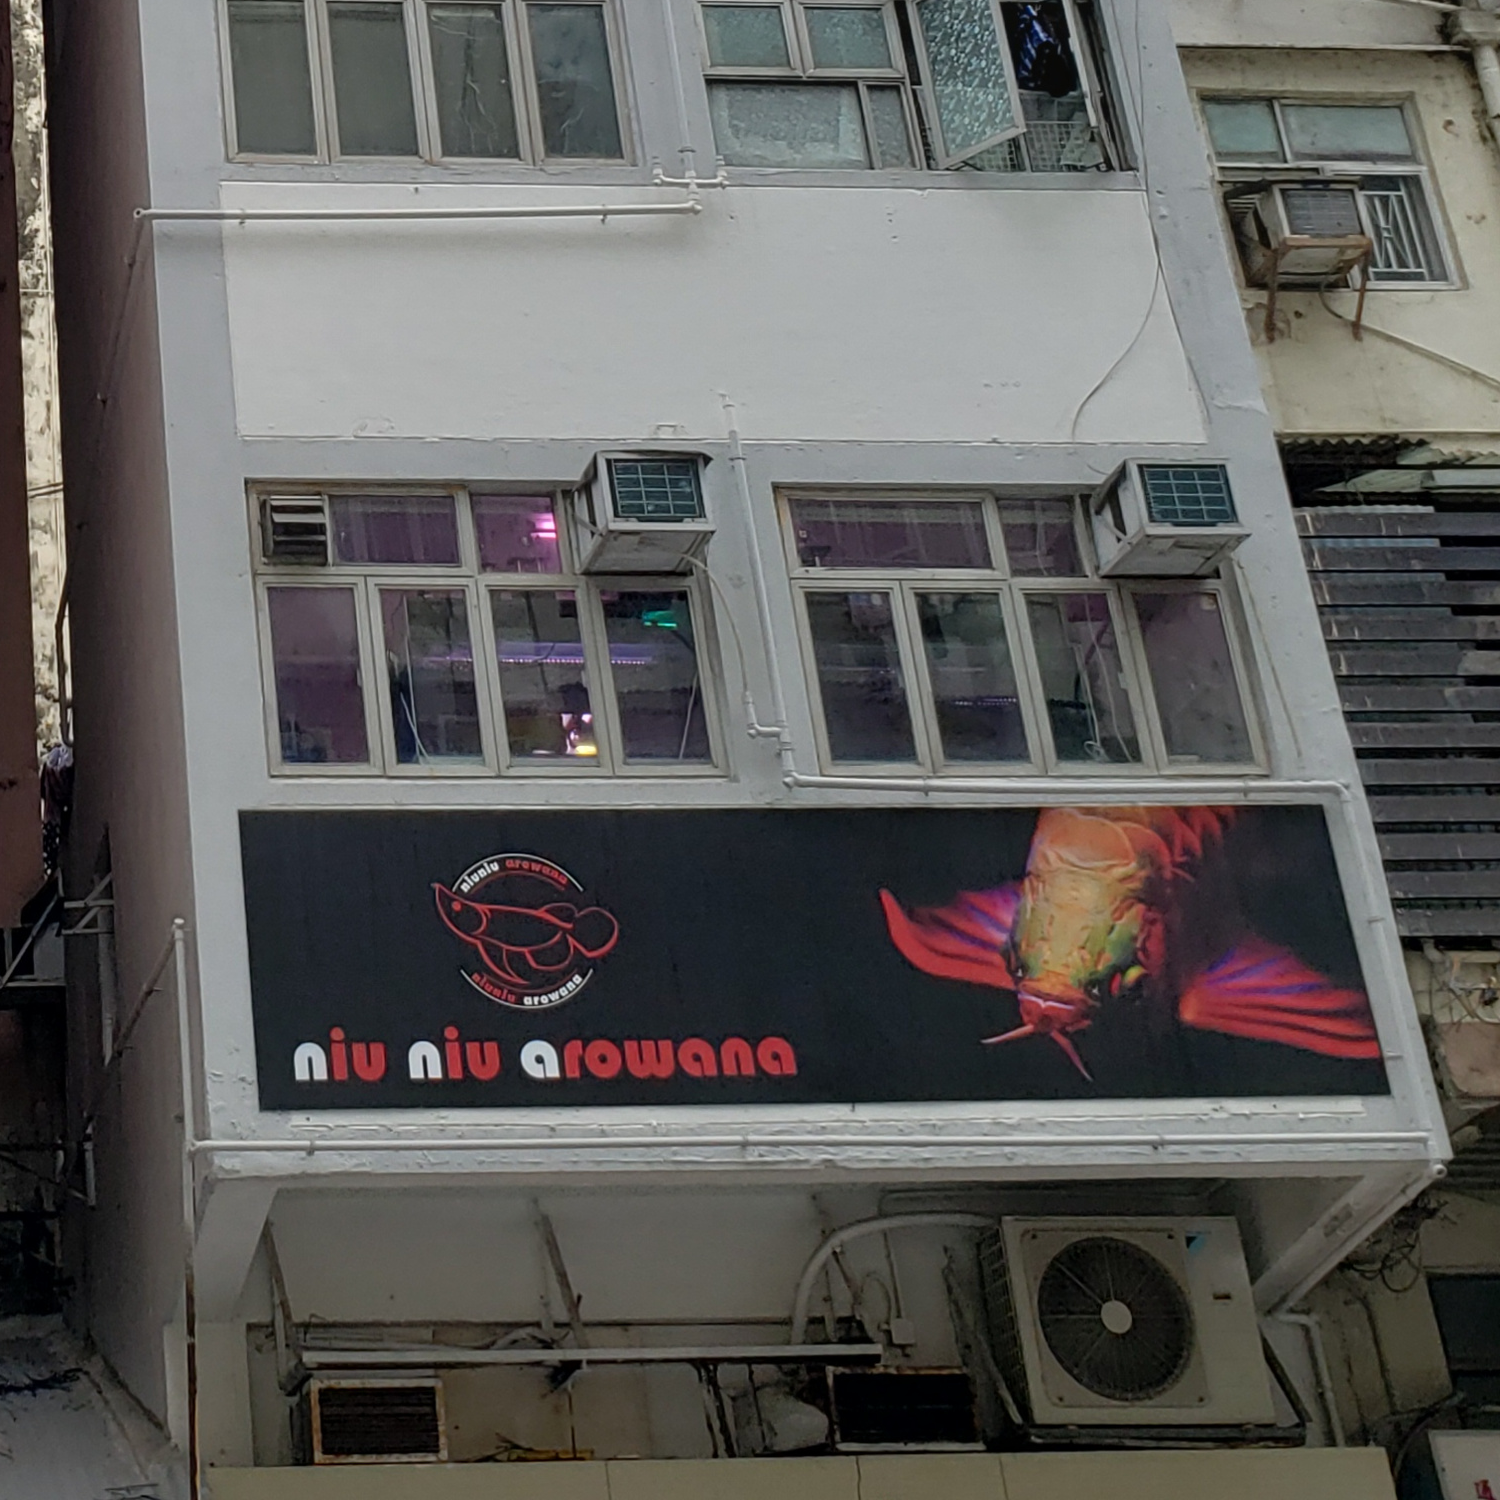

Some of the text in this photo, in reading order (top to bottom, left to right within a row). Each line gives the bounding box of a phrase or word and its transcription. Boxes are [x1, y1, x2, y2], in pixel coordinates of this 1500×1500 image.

[505, 858, 568, 885] arowana
[523, 973, 583, 1006] arowana
[293, 1026, 797, 1081] niu niu arowana
